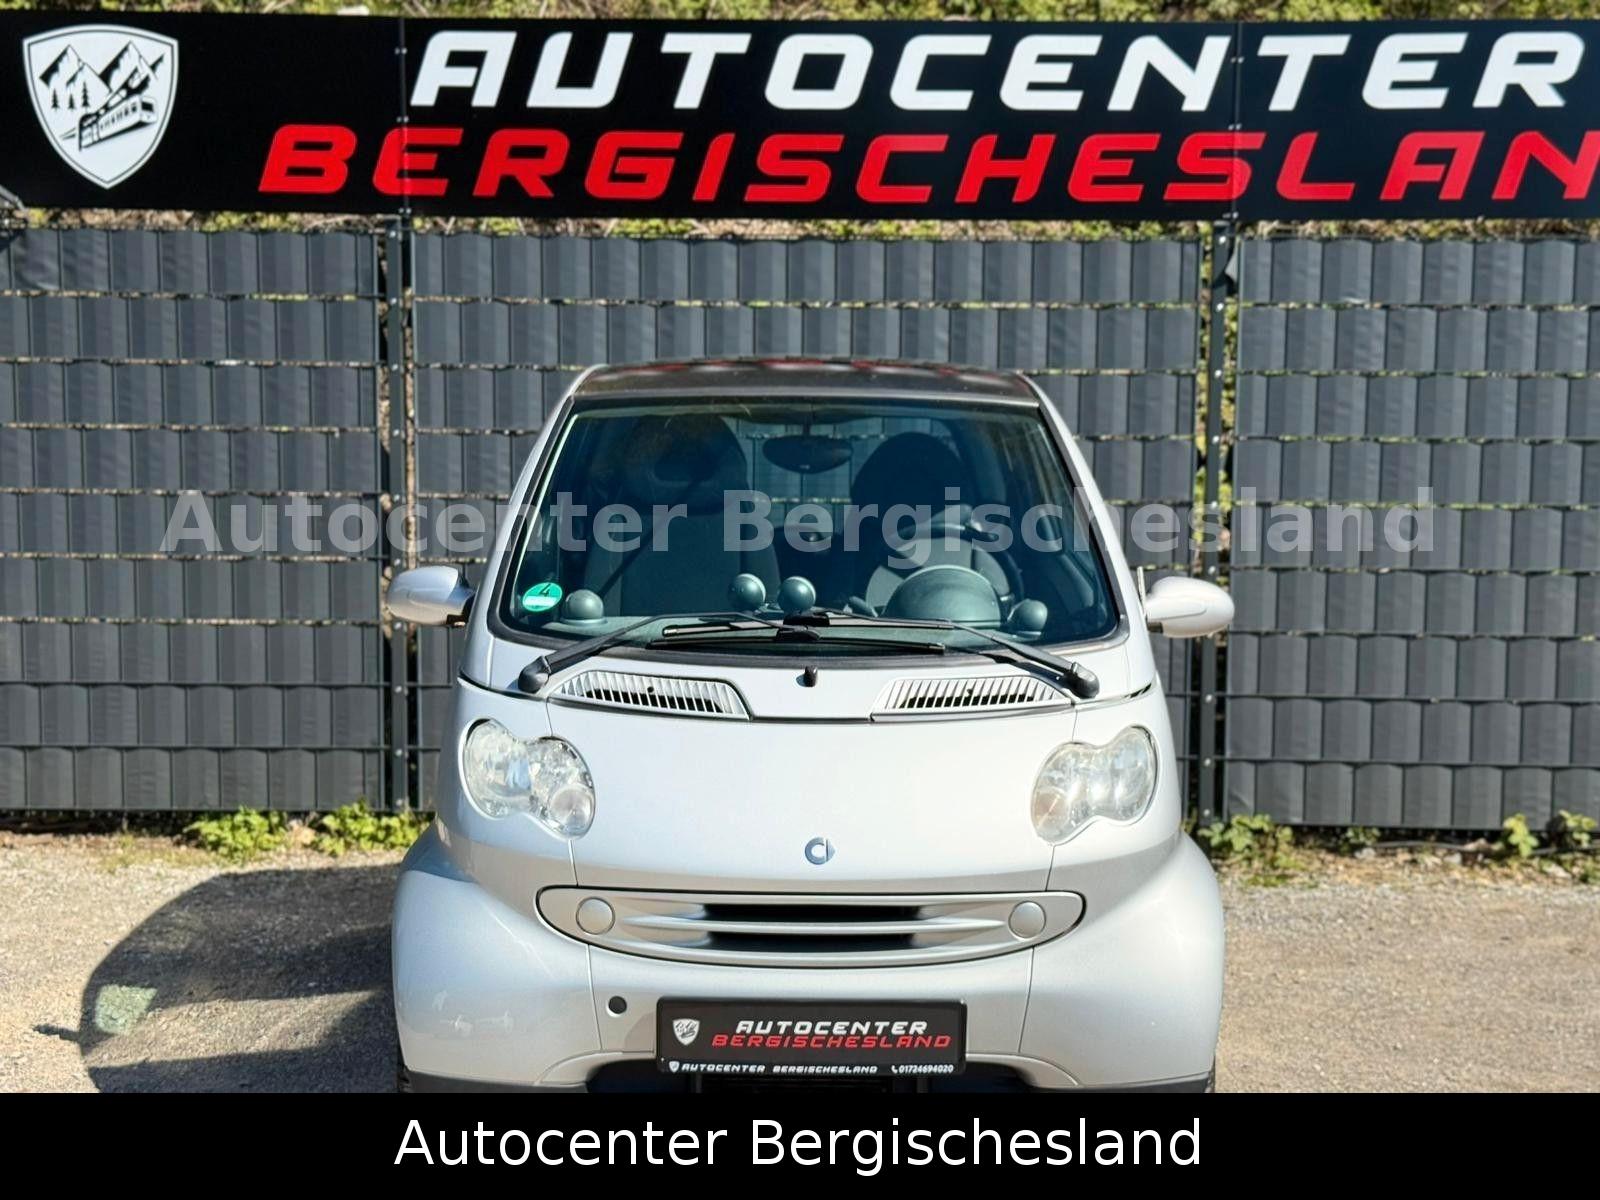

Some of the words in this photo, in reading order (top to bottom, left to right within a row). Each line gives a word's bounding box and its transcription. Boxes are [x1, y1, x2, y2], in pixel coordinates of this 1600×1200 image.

[410, 30, 1585, 112] AUTOCENTER
[539, 584, 551, 597] 4
[735, 1020, 928, 1035] AUTOCENTER
[711, 1034, 951, 1049] BERGISCHESLAND
[681, 1063, 766, 1073] AUTOCENTER
[772, 1064, 878, 1074] BERGISCHESLAND
